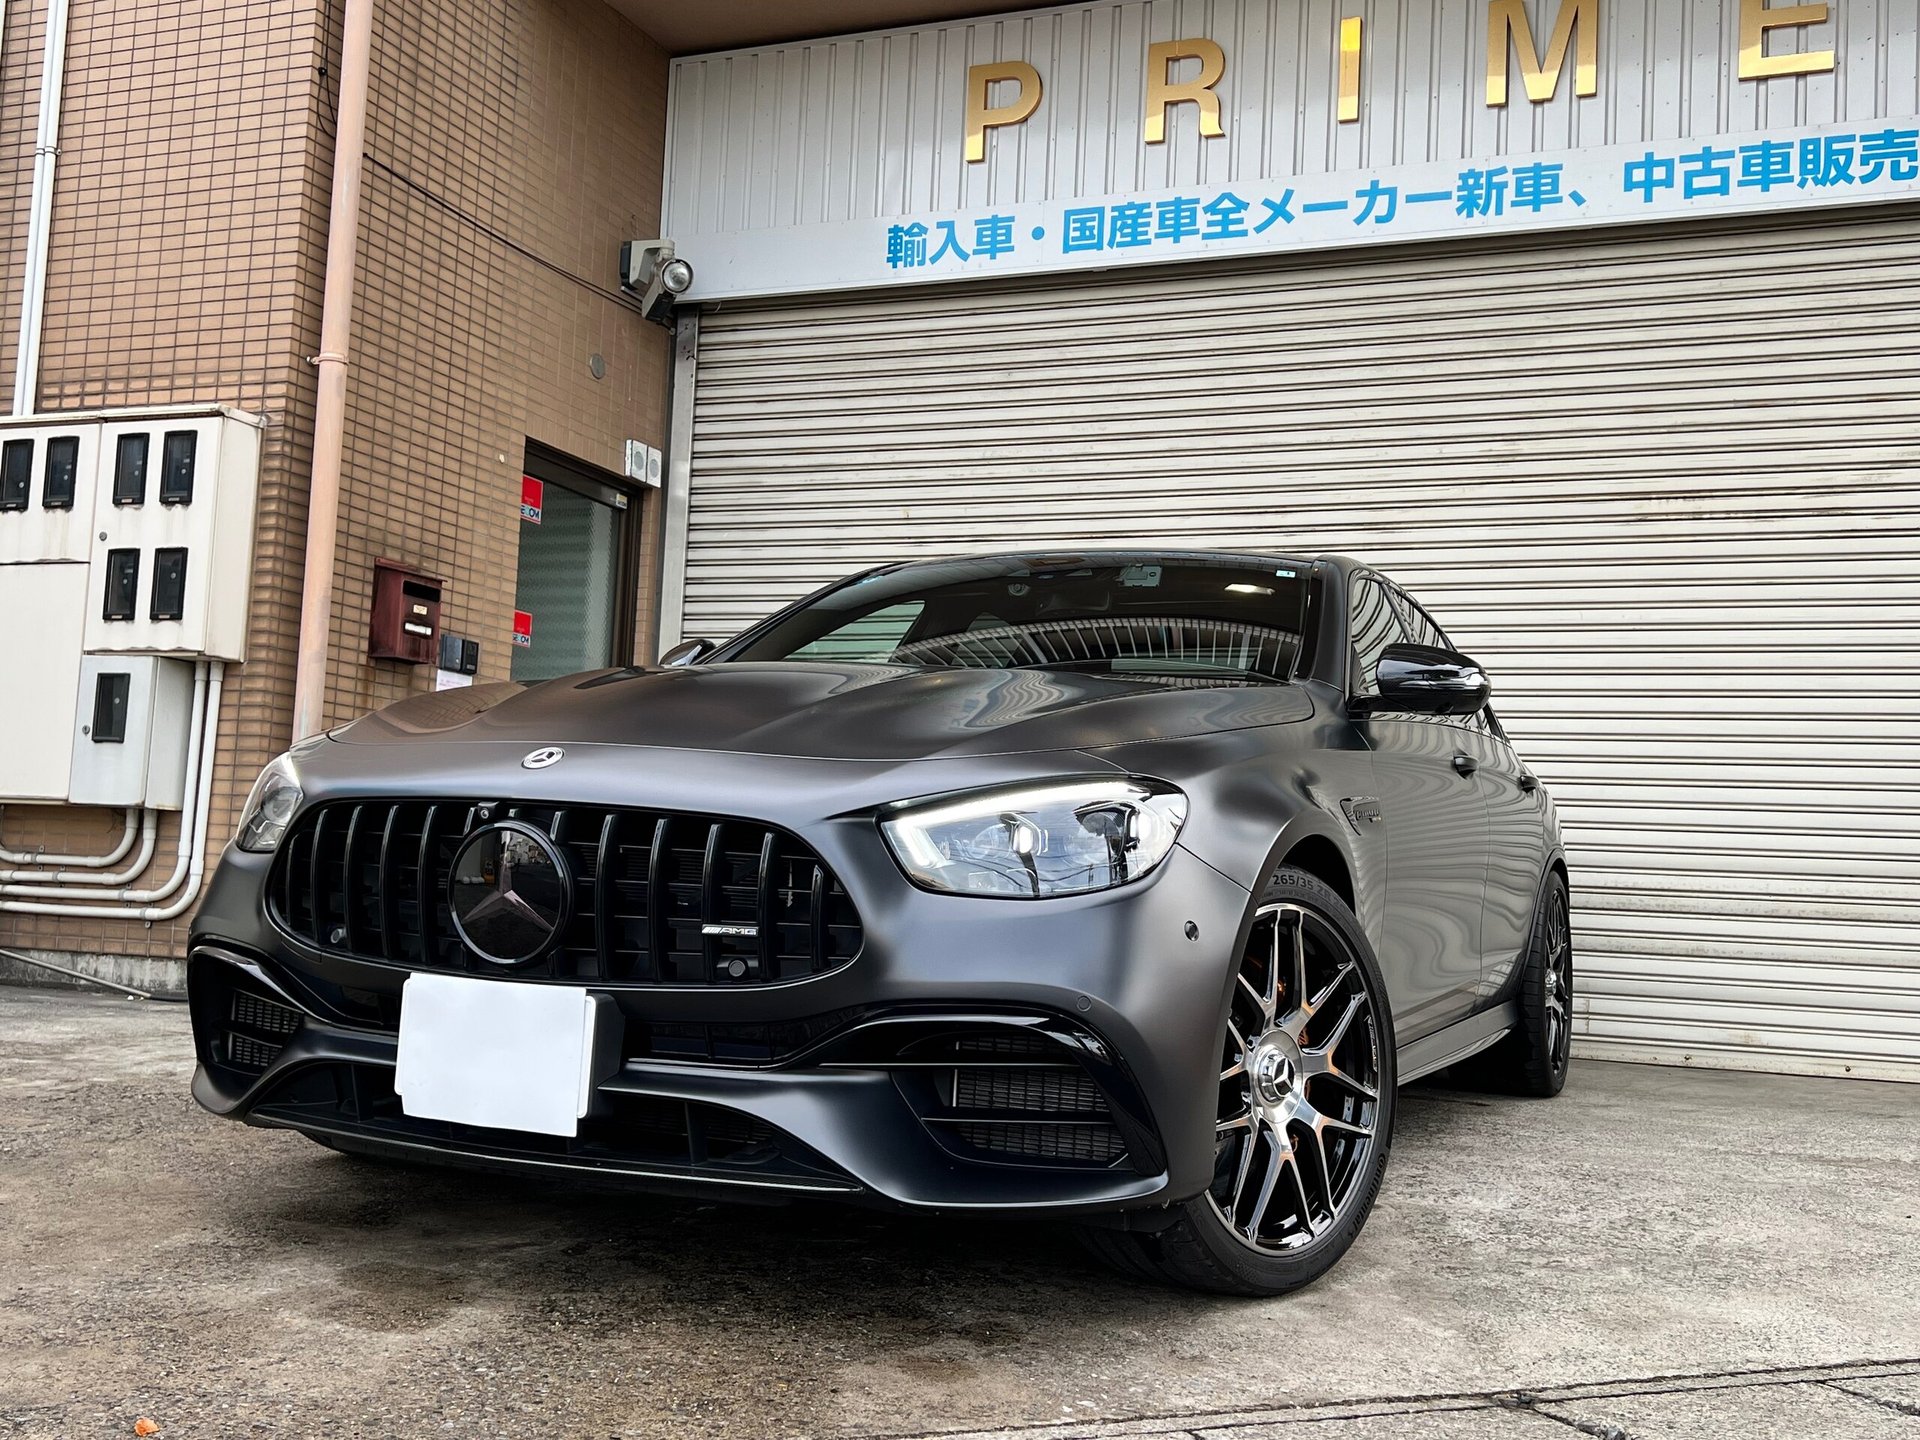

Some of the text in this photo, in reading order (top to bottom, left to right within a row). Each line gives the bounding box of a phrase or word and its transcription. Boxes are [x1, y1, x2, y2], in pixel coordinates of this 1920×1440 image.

[965, 0, 1836, 163] PRIME
[886, 129, 1920, 268] 輸入車・国産車全メーカー新車、中古車販売
[1272, 874, 1314, 890] 265/35
[720, 927, 757, 936] AMG
[1353, 1153, 1386, 1231] Continental
